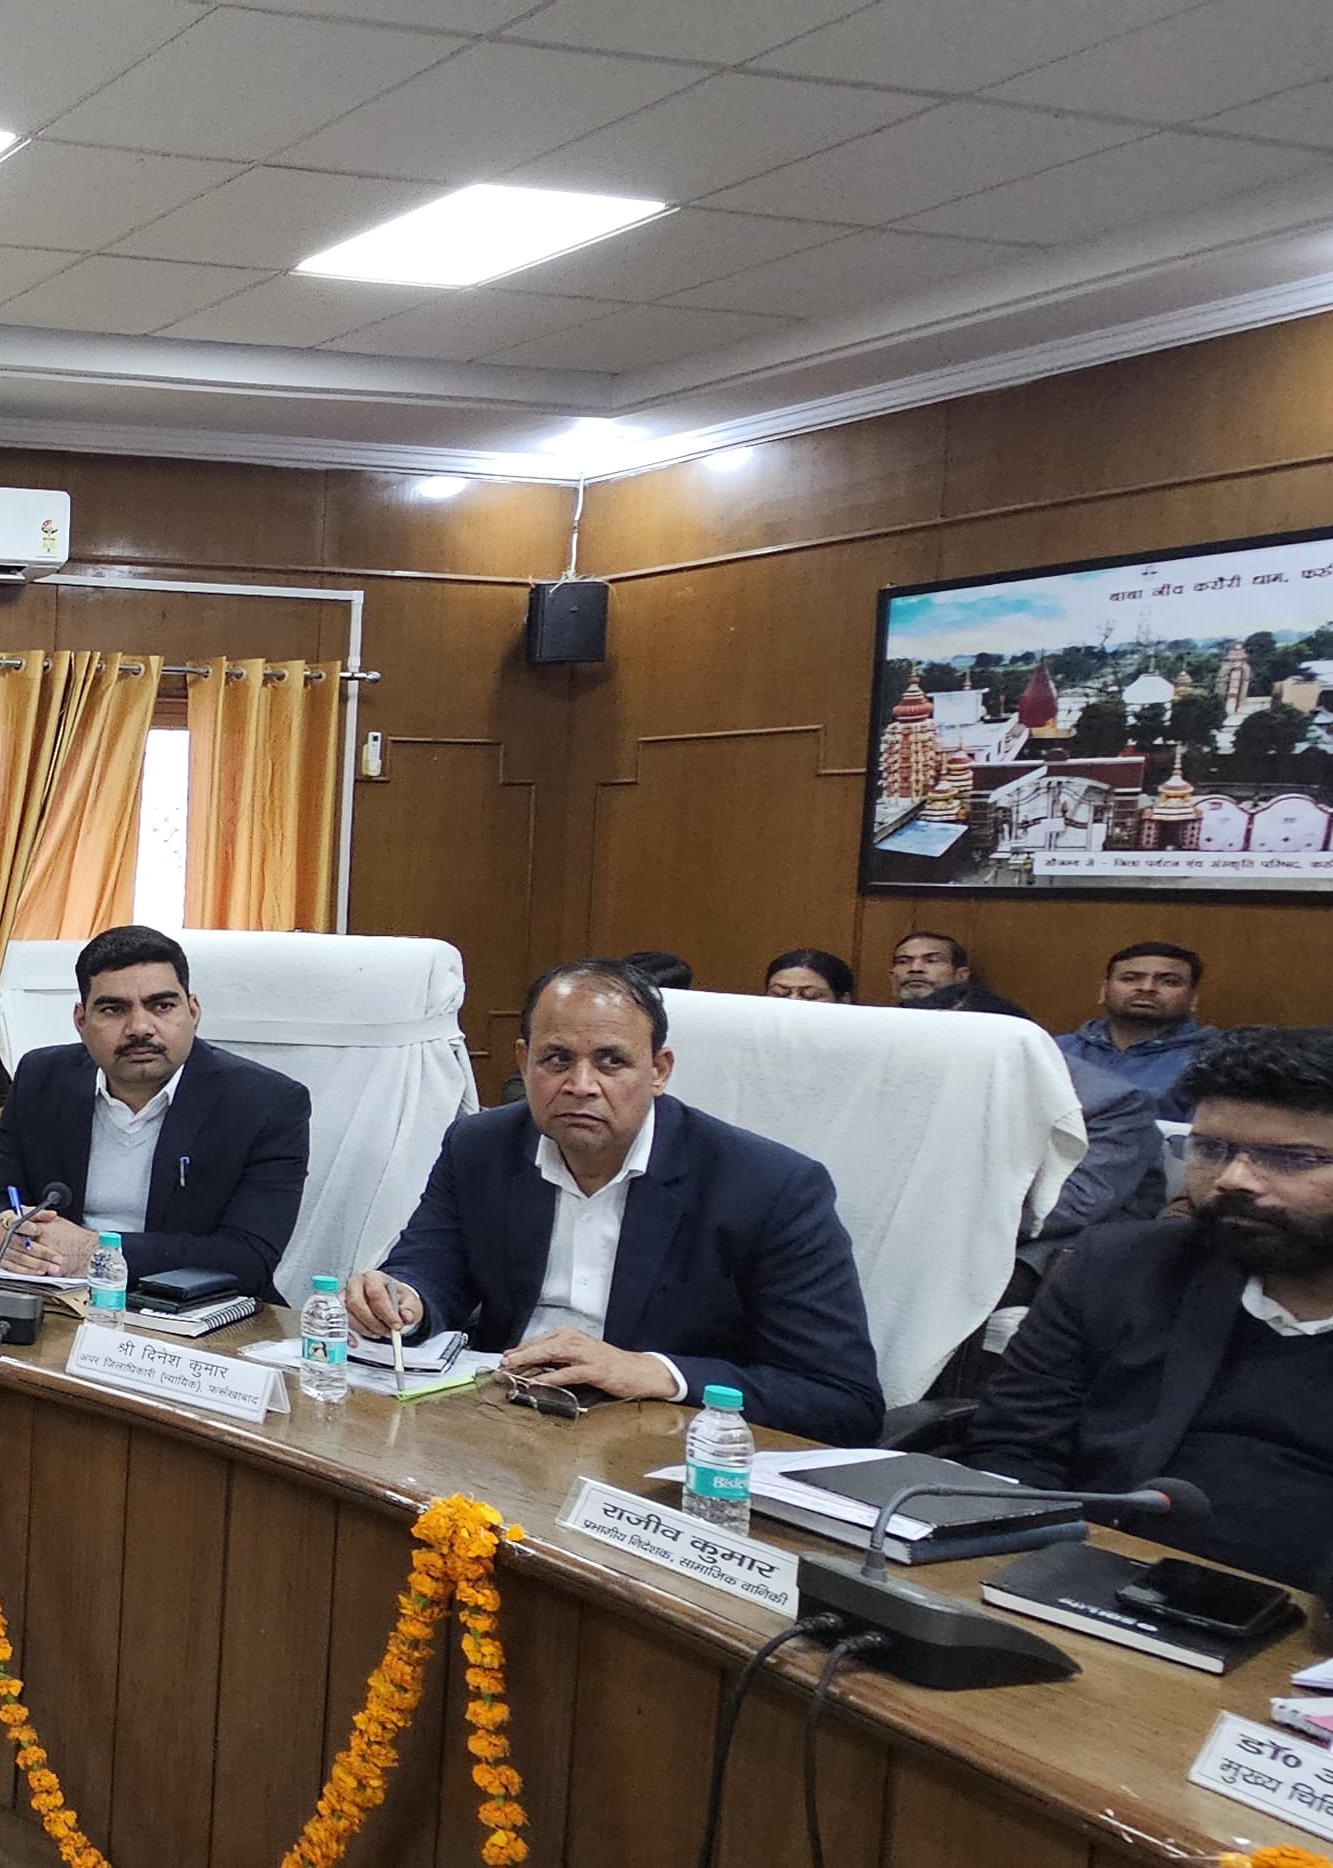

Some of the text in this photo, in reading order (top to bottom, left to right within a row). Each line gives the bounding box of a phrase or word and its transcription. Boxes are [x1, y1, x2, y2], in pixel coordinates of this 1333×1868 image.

[79, 1353, 99, 1366] अपर
[103, 1357, 155, 1379] जिलाधिकारी
[117, 1341, 229, 1379] श्री दिनेश कुमार
[602, 1501, 780, 1580] राजीव कुमार
[583, 1518, 627, 1542] प्रभागीय
[679, 1556, 738, 1587] सामाजिक
[741, 1580, 789, 1608] वानिकी
[1220, 1756, 1284, 1794] मुख्य
